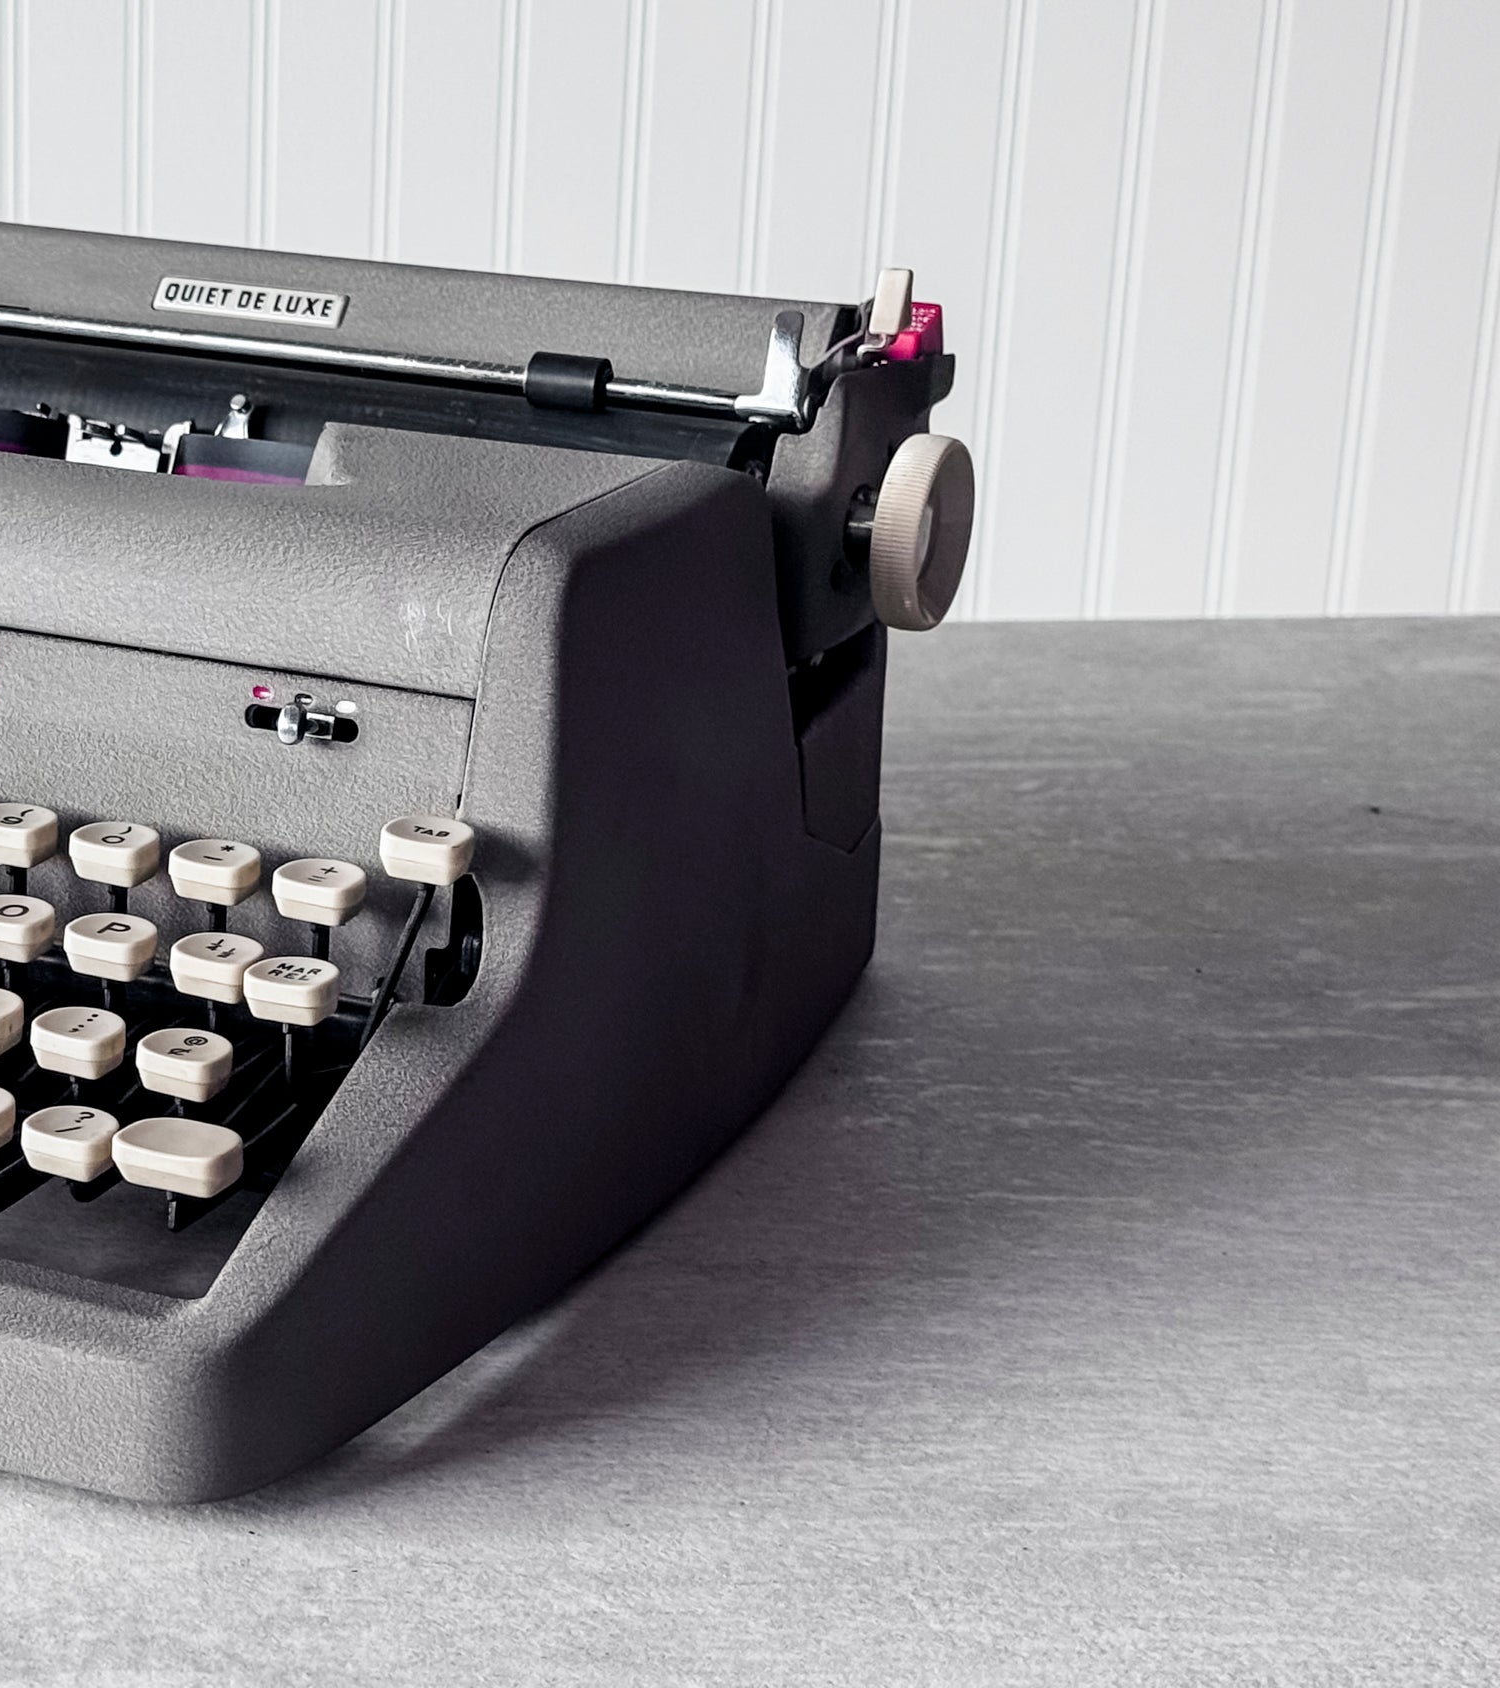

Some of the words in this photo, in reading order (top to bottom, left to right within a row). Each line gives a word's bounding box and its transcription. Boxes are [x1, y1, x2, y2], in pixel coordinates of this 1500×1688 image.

[165, 282, 232, 305] QUIET
[238, 291, 266, 309] DE
[274, 295, 333, 316] LUXE
[413, 825, 450, 838] TAB
[97, 922, 131, 933] P
[268, 969, 311, 981] REL
[275, 962, 322, 977] MAR
[184, 1036, 209, 1047] @
